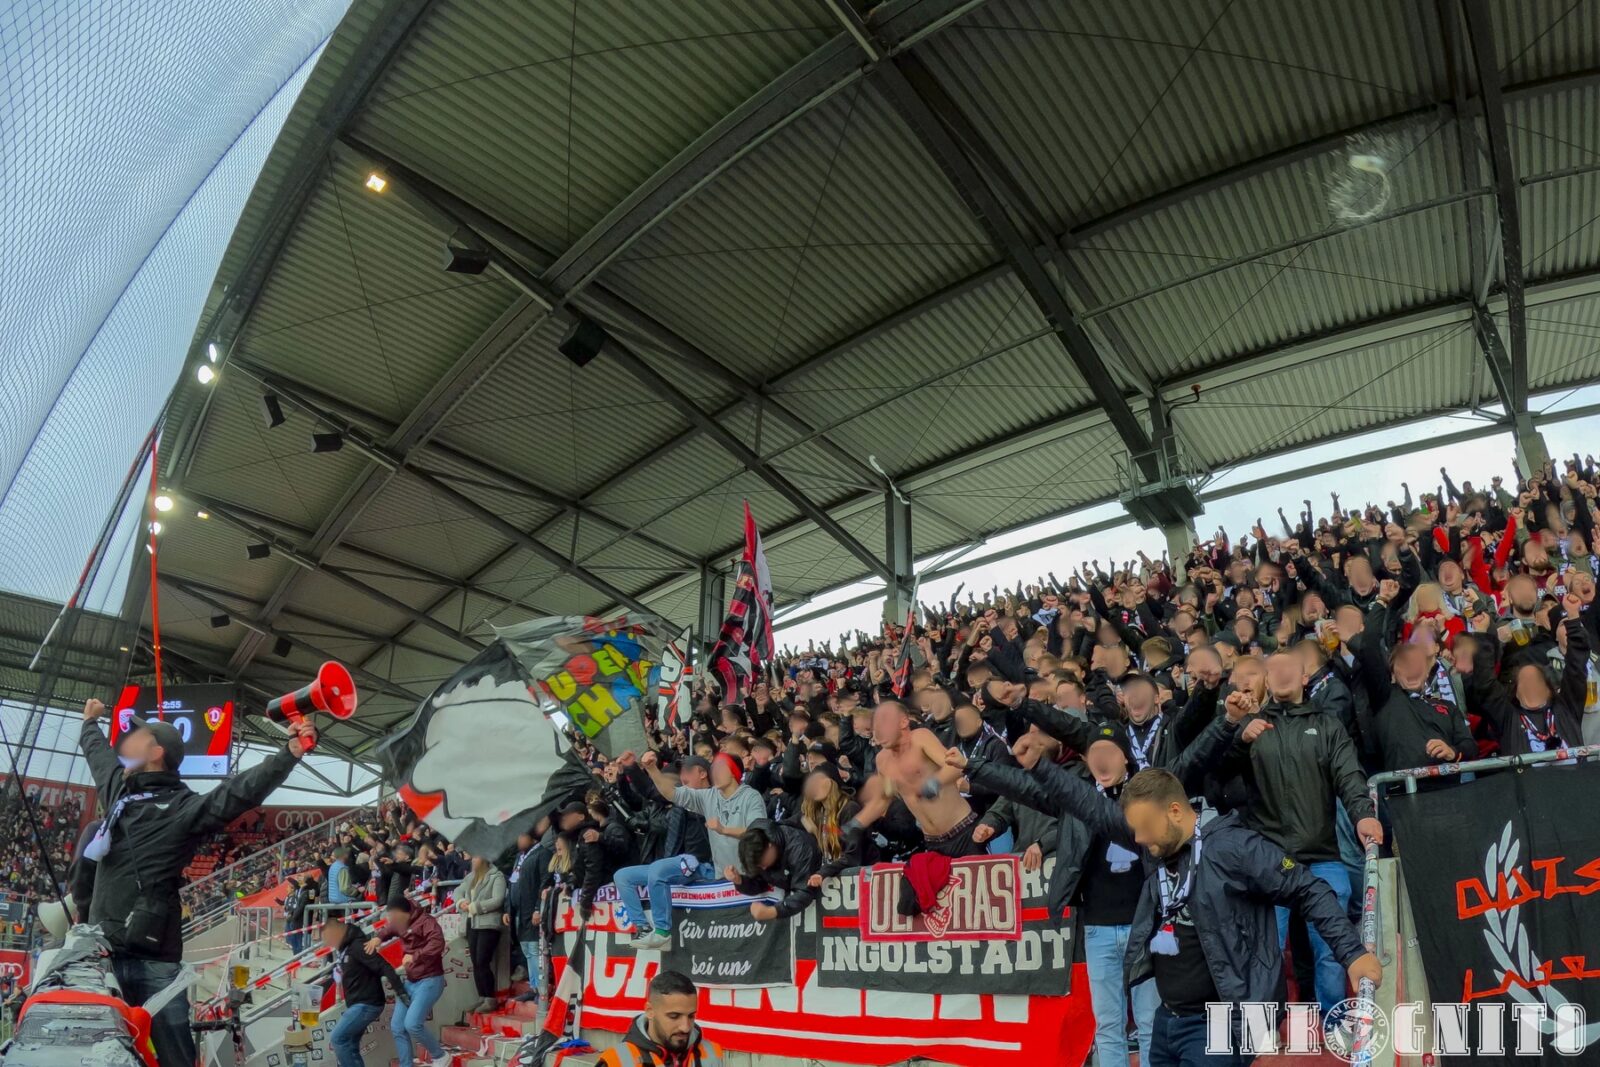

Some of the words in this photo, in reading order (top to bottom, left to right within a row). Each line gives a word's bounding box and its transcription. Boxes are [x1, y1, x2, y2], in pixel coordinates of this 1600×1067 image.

[871, 864, 1014, 933] ULRAS
[679, 919, 705, 948] für
[708, 920, 767, 939] immer
[821, 928, 1070, 975] INGOLSTADT
[717, 959, 752, 976] uns
